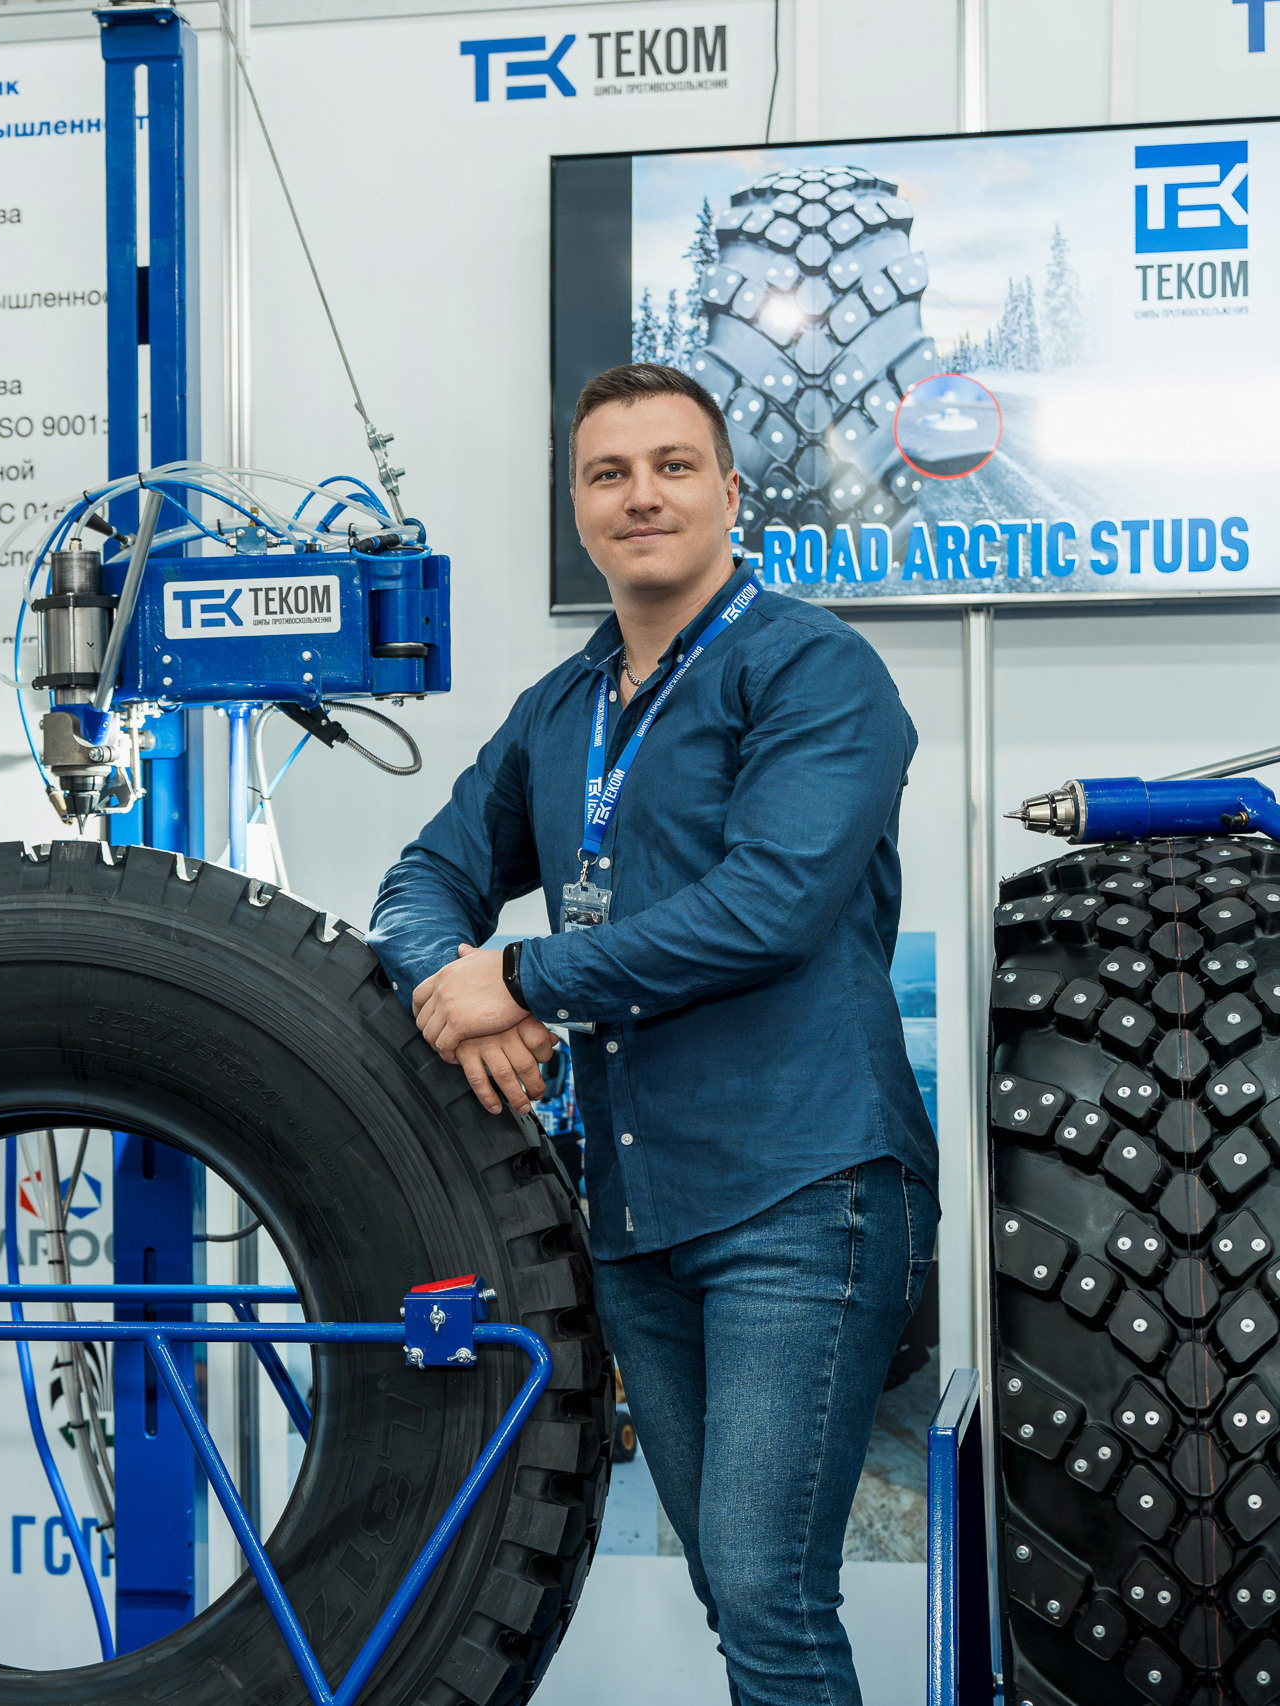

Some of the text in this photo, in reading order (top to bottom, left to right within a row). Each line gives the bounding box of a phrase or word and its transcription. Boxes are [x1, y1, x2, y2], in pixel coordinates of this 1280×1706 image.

[588, 25, 727, 78] ТЕКОМ
[1135, 260, 1248, 301] ТЕКОМ
[902, 518, 1079, 582] ARCTIC
[1090, 516, 1249, 575] STUDS
[249, 585, 331, 616] ТЕКОМ
[735, 583, 759, 609] ТЕКОМ
[637, 645, 704, 738] ШИПЫ ПРОТИВОСКОЛЬЖЕНИЯ
[601, 768, 626, 803] ТЕКОМ
